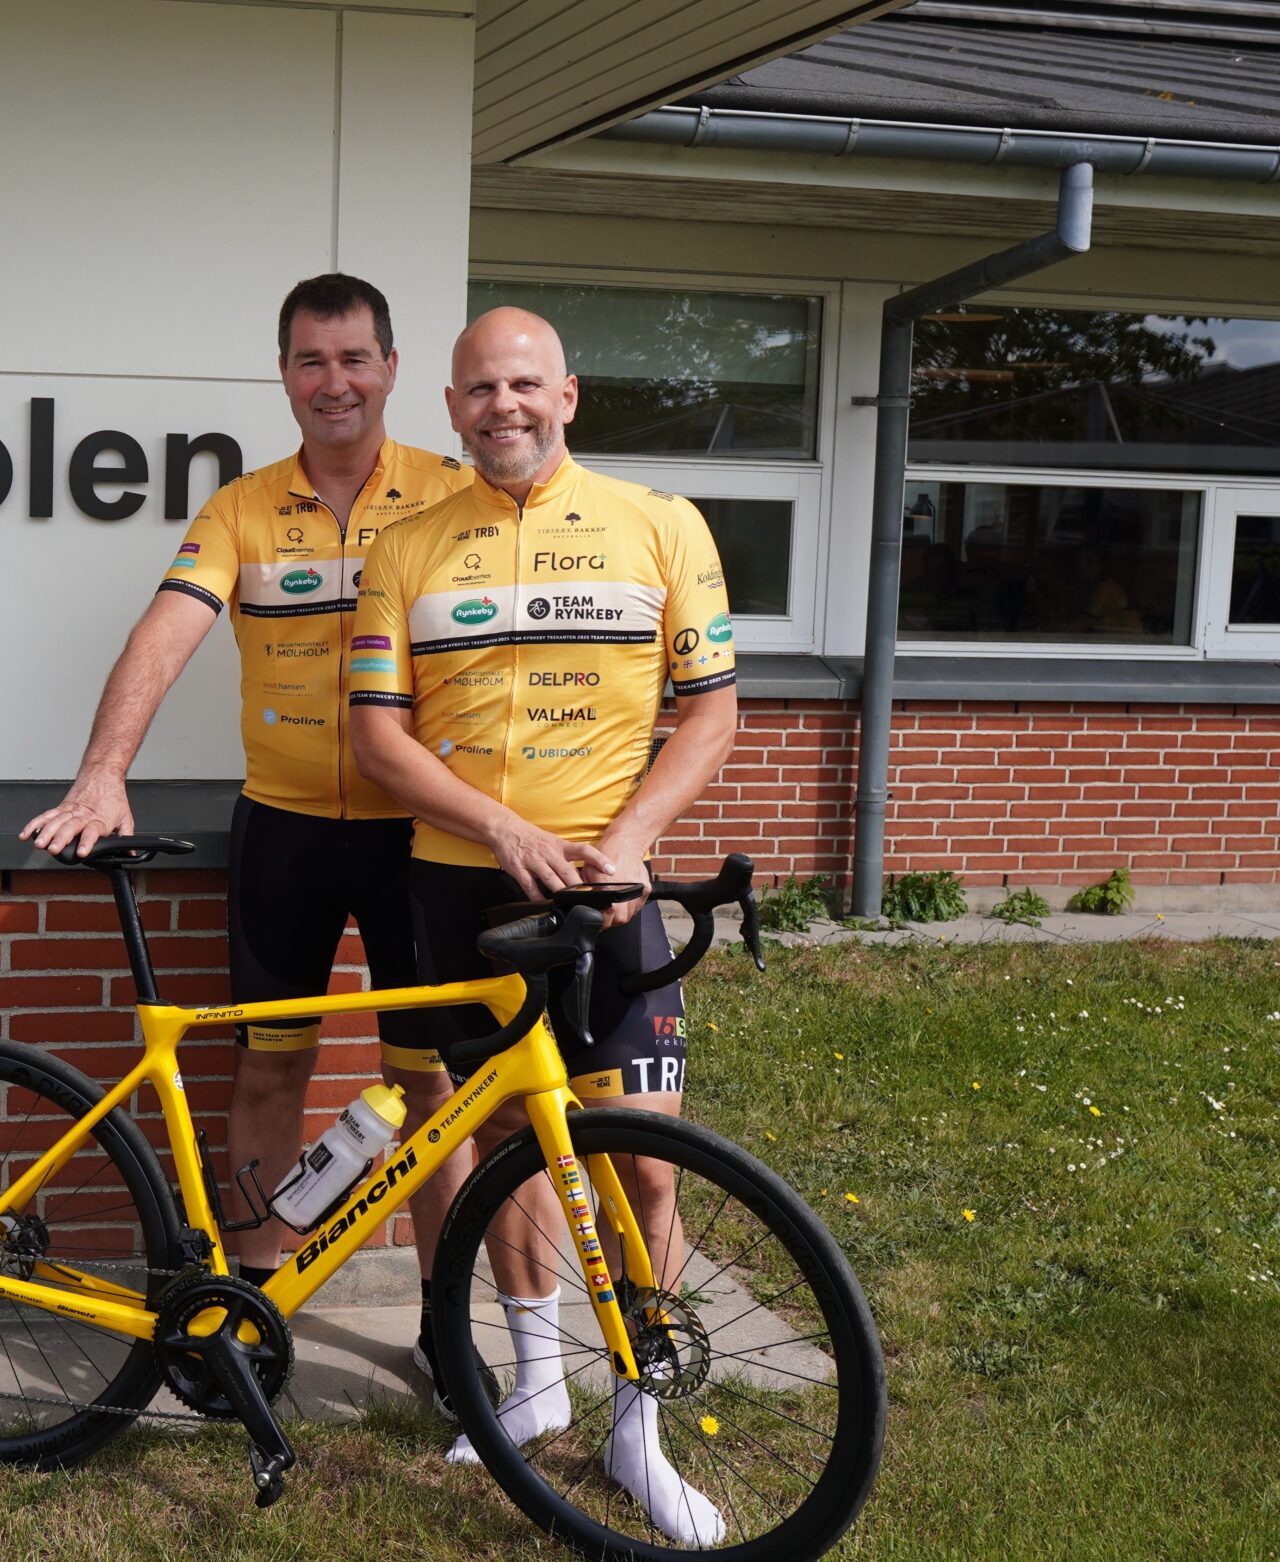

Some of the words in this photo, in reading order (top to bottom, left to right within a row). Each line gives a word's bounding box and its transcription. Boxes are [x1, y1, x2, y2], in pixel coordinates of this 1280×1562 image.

[534, 552, 604, 572] Flora
[284, 576, 318, 587] Rynkeby
[452, 572, 492, 583] Cloudberries
[552, 596, 594, 608] TEAM
[456, 606, 494, 618] Rynkeby
[554, 609, 624, 620] RYNKEBY
[276, 648, 330, 658] MØLHOLM
[454, 677, 504, 687] MØLHOLM
[528, 672, 600, 686] DELPRO
[280, 715, 326, 726] Proline
[527, 708, 597, 721] VALHAL
[456, 744, 493, 756] Proline
[538, 747, 592, 758] UBIDOGY
[196, 1010, 244, 1020] INFINITO
[440, 1106, 464, 1130] TEAM
[463, 1069, 500, 1109] RYNKEBY
[348, 1114, 360, 1128] TEAM
[344, 1120, 366, 1140] RYNKEBY
[296, 1146, 418, 1275] Bianchi
[57, 1305, 96, 1319] Bianchi
